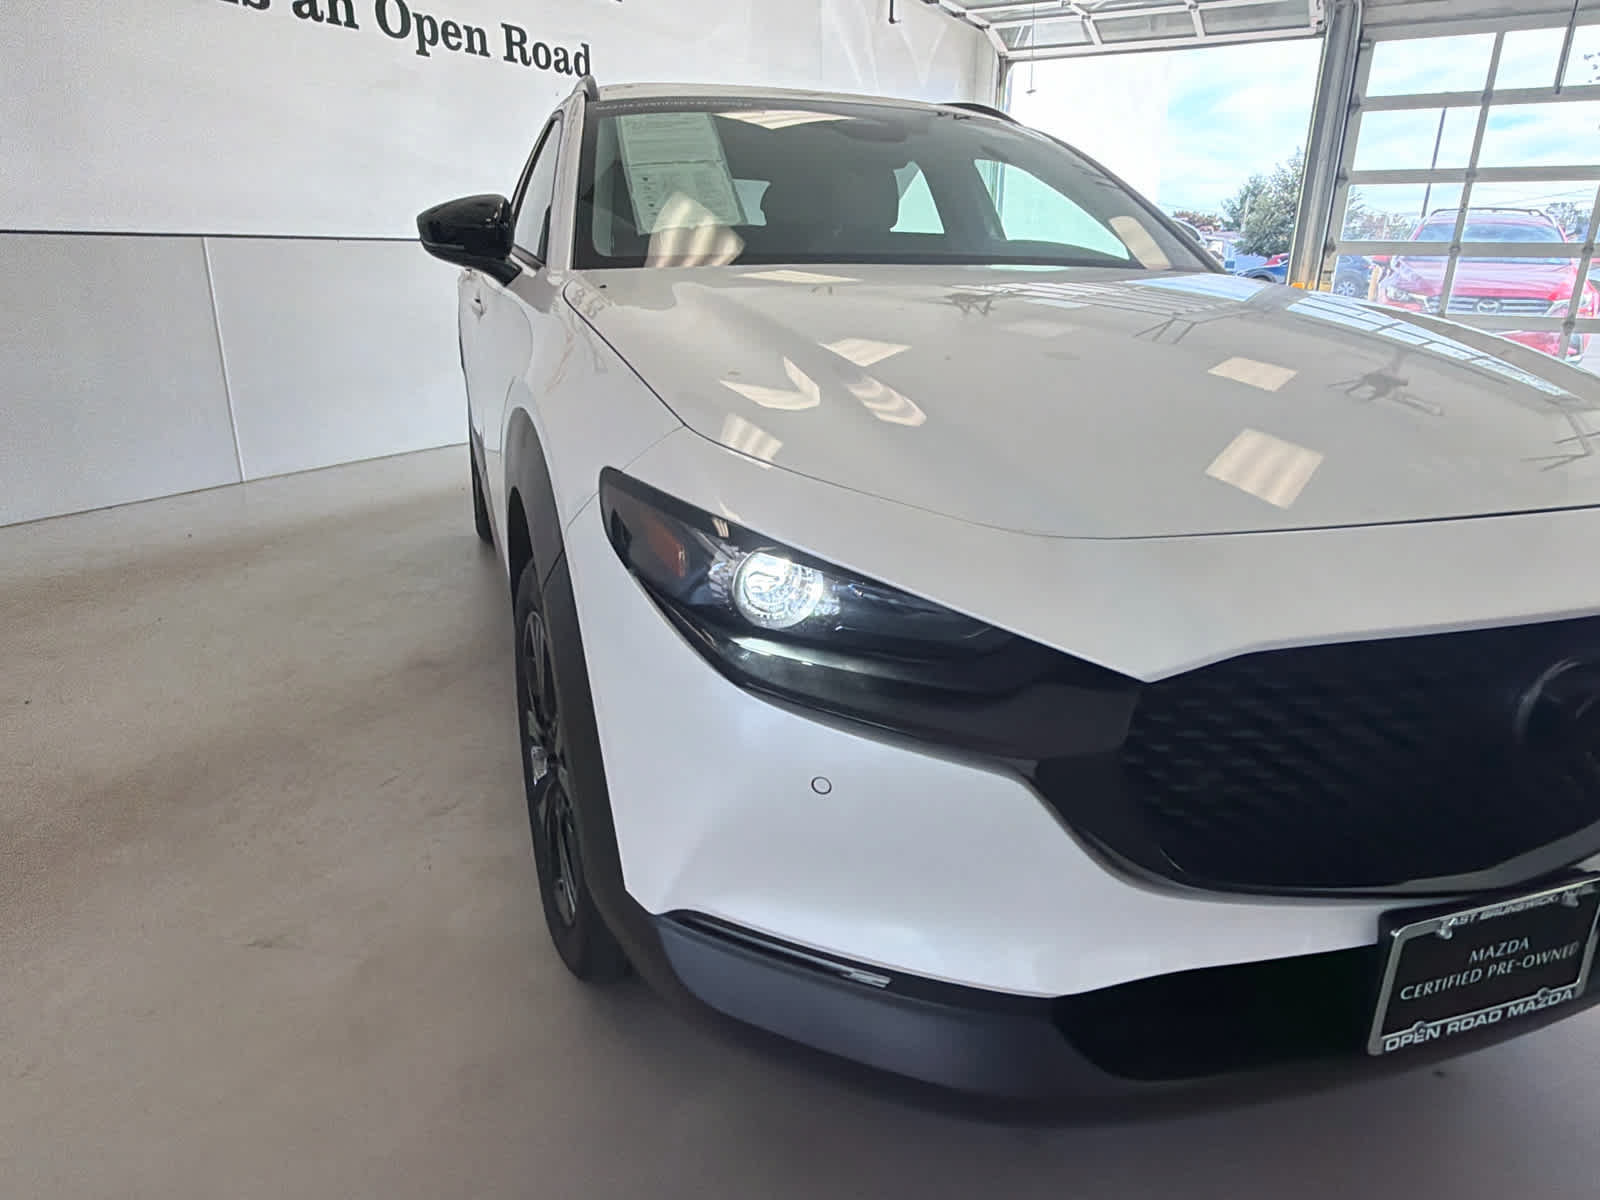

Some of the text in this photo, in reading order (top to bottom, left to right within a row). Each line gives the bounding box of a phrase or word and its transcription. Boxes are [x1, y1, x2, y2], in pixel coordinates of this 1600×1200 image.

[374, 0, 491, 57] Open
[500, 22, 592, 78] Road
[1469, 938, 1529, 963] MAZDA
[1400, 967, 1483, 1001] CERTIFIED
[1385, 989, 1574, 1052] OPEN ROAD MAZDA
